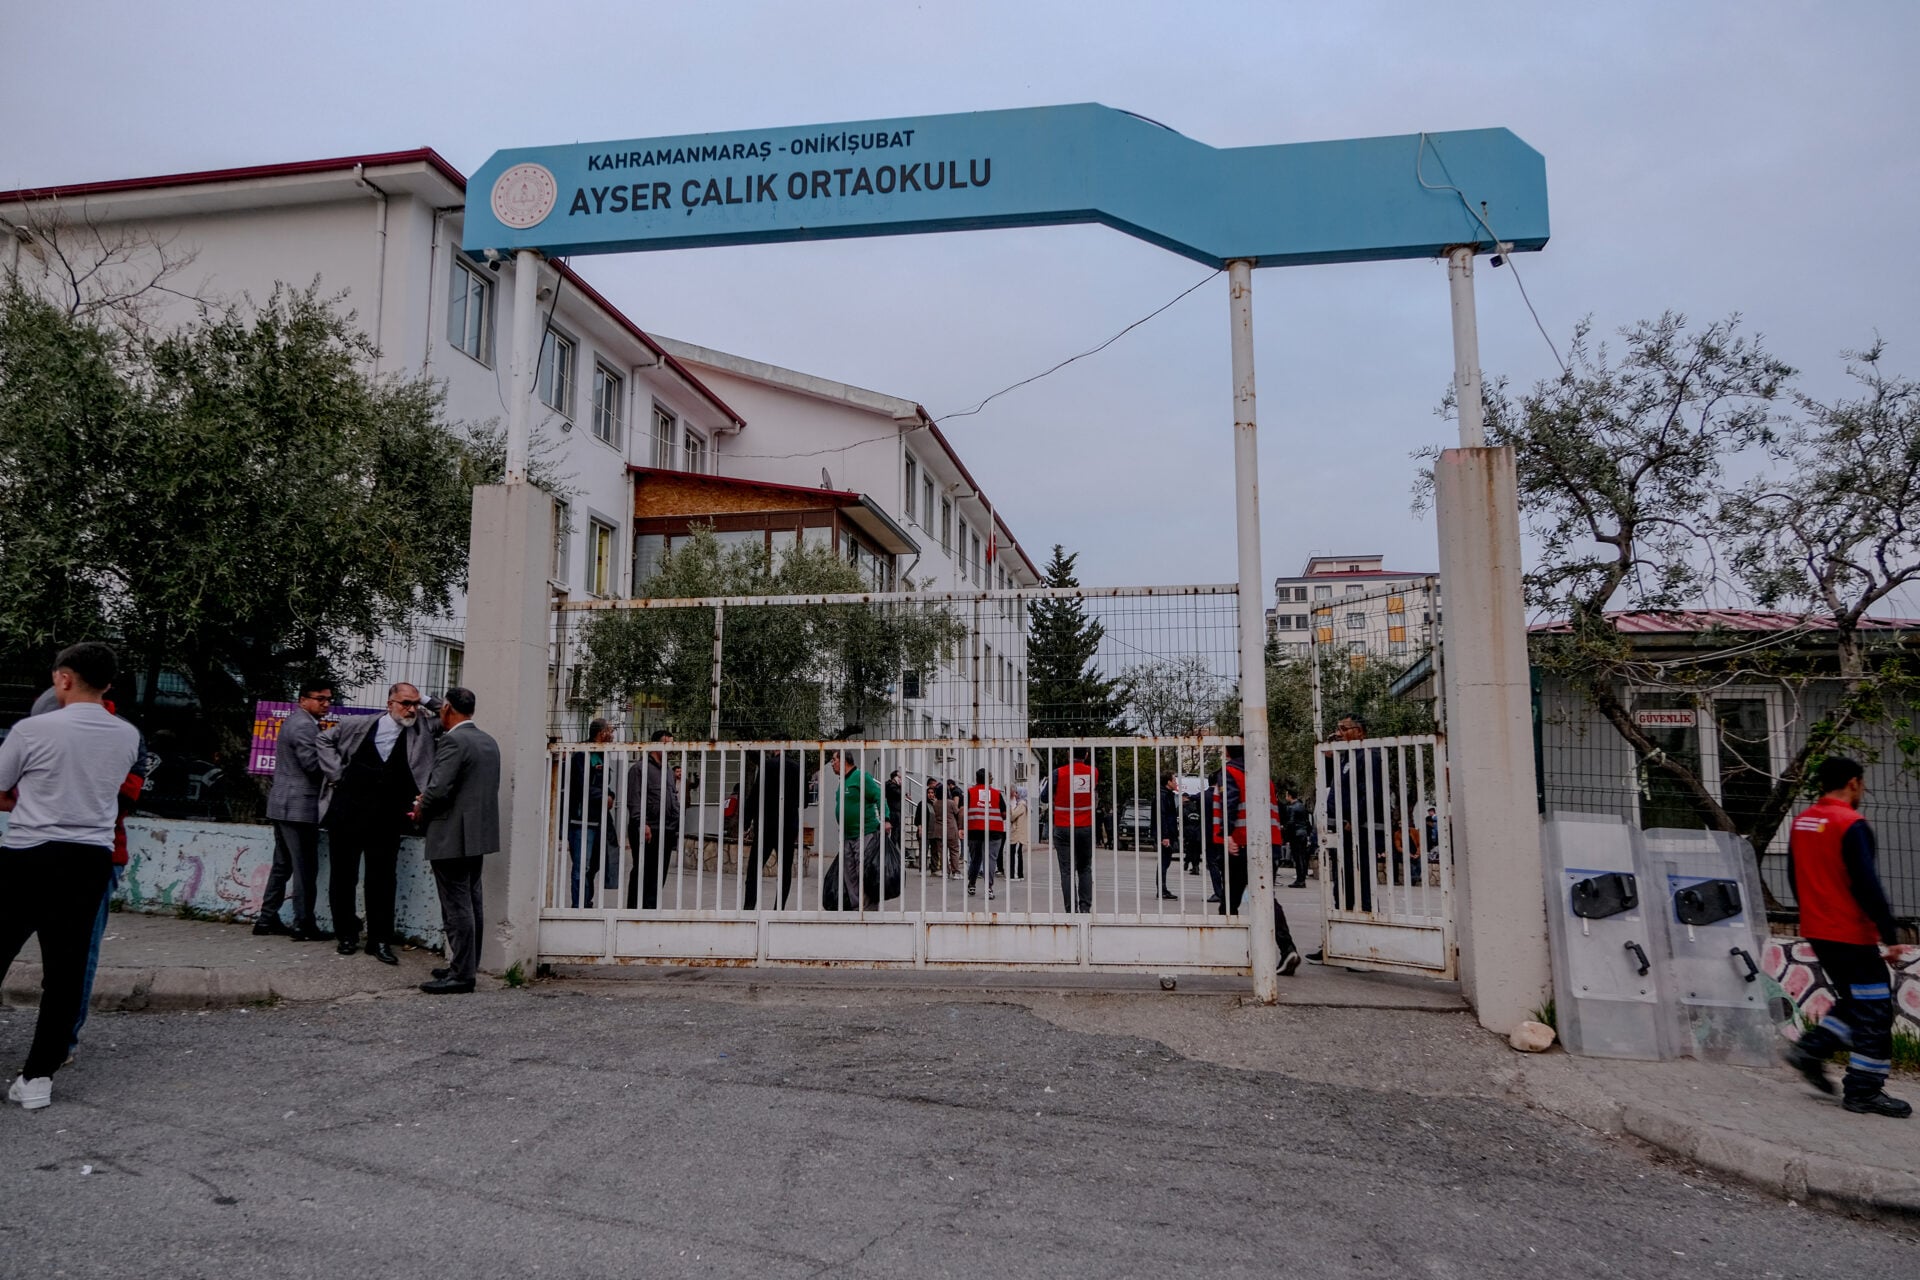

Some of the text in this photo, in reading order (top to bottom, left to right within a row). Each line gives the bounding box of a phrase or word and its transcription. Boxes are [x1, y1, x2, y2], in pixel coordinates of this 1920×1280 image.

[588, 141, 771, 171] KAHRAMANMARAŞ
[790, 129, 915, 155] ONİKİŞUBAT
[569, 182, 671, 216] AYSER
[682, 173, 778, 216] ÇALIK
[787, 158, 991, 200] ORTAOKULU
[1639, 712, 1692, 723] GÜVENLİK
